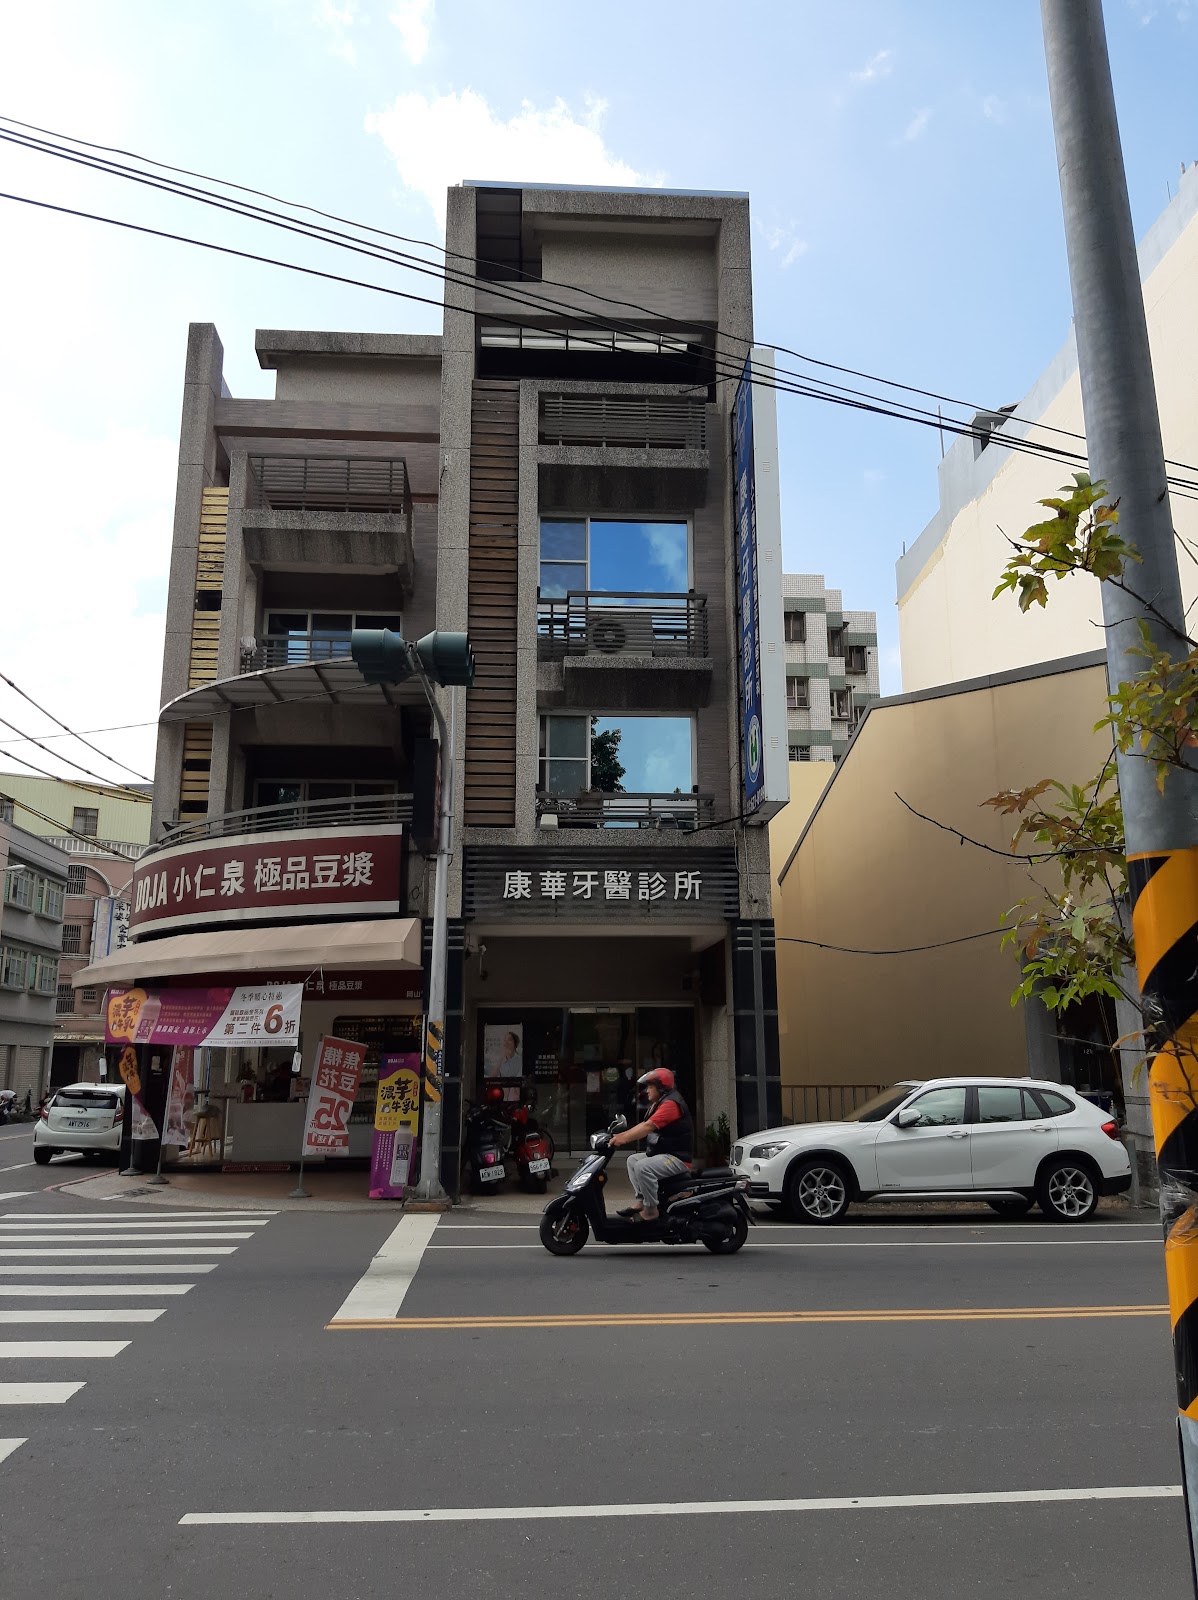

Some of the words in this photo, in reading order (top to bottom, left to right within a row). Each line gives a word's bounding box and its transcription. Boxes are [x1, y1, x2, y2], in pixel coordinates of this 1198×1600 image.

[739, 467, 753, 714] 康華牙醫診所
[134, 871, 168, 914] DOJA
[172, 859, 246, 903] 小仁泉
[253, 851, 375, 893] 極品豆漿
[502, 869, 703, 901] 康華牙醫診所
[391, 1098, 419, 1115] 牛乳
